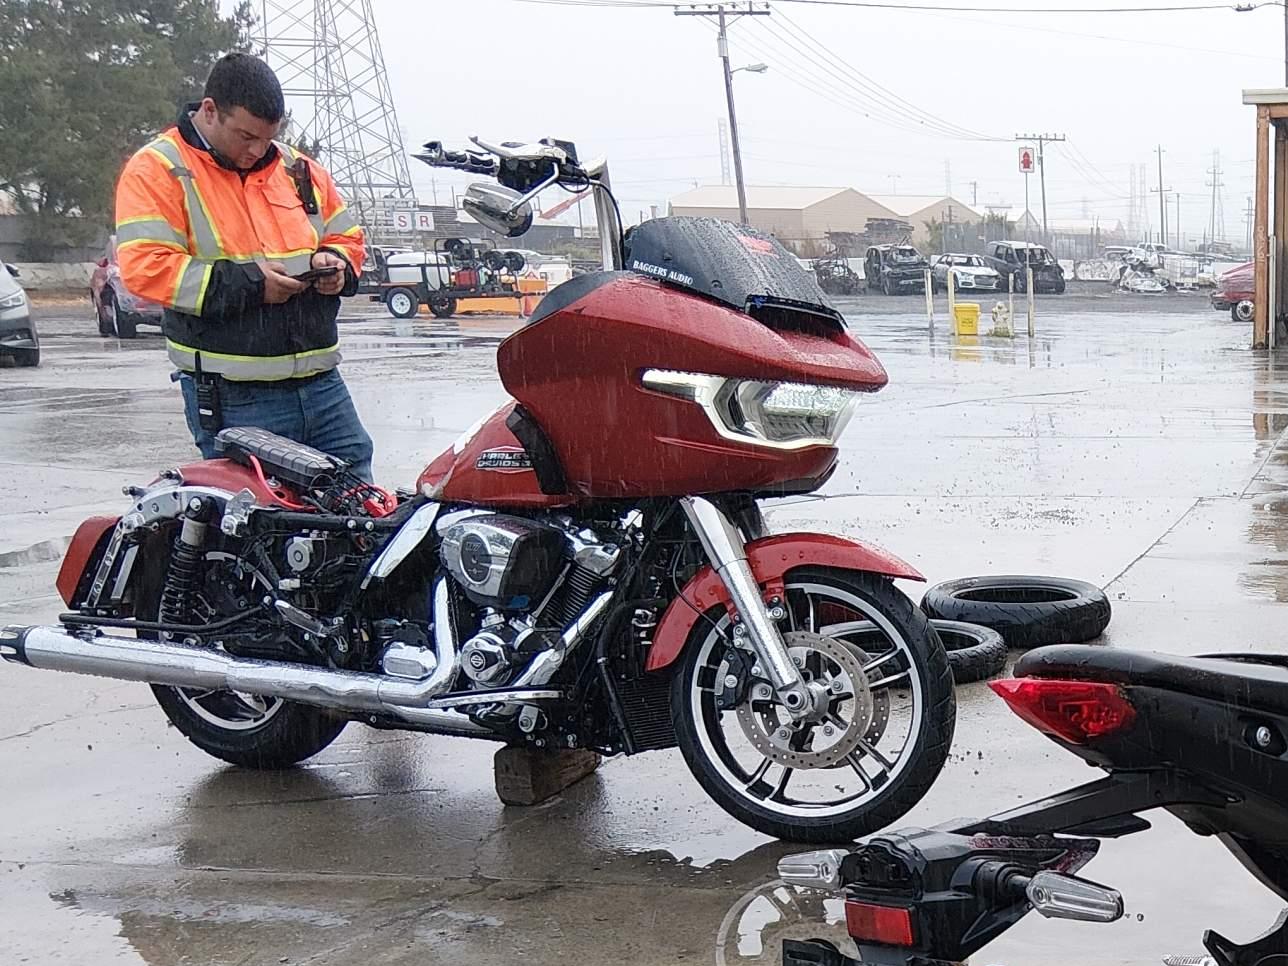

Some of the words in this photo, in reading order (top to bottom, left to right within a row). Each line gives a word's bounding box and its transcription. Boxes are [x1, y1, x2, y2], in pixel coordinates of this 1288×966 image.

[398, 215, 407, 228] S
[420, 215, 430, 227] R
[633, 260, 668, 277] BAGGERS
[668, 270, 694, 285] AUDIO
[477, 460, 532, 468] DAVIDSO
